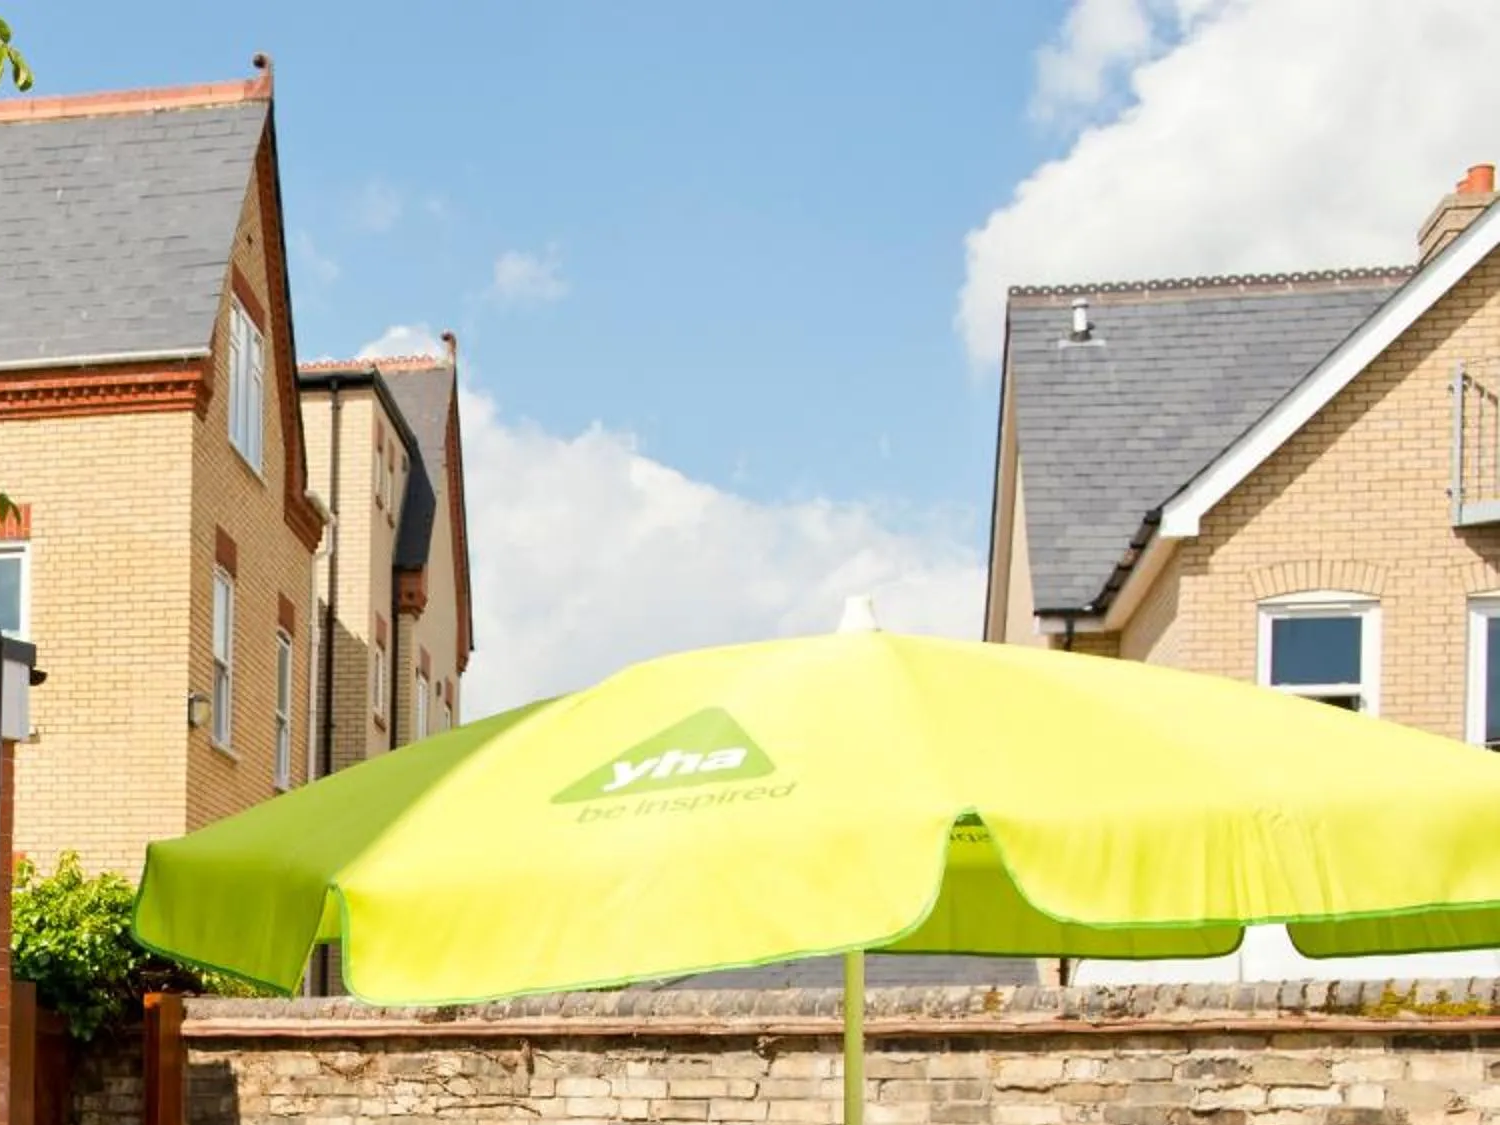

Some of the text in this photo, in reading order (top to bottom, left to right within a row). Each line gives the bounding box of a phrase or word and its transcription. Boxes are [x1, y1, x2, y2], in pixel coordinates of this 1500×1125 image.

[602, 748, 748, 792] yha
[577, 782, 797, 823] be inspired
